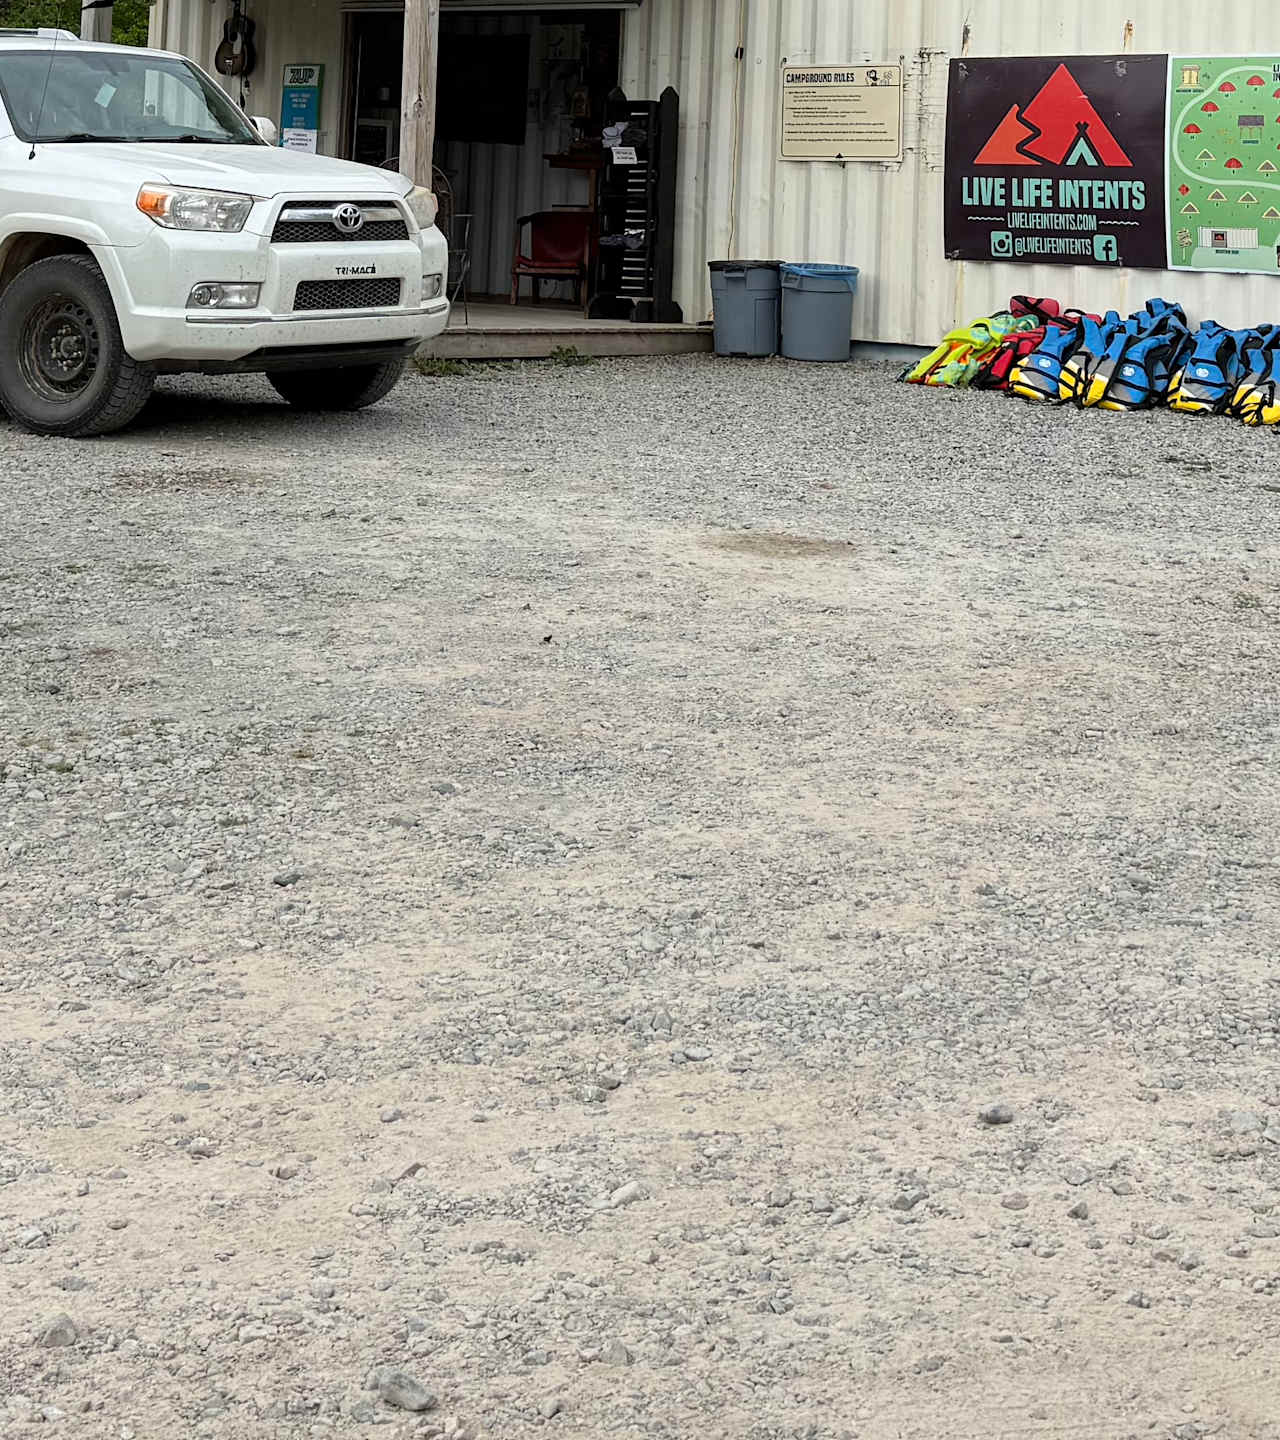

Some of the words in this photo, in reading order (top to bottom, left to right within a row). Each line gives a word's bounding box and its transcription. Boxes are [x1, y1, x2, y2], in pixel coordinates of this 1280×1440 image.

[786, 73, 832, 83] CAMPGROUND
[833, 72, 855, 83] RULES
[962, 176, 1006, 206] LIVE
[1012, 177, 1053, 208] LIFE
[1058, 179, 1146, 210] INTENTS
[1007, 212, 1097, 231] LIVELIFEINTENTS.COM
[1014, 236, 1092, 256] @LIVELIFEINTENTS
